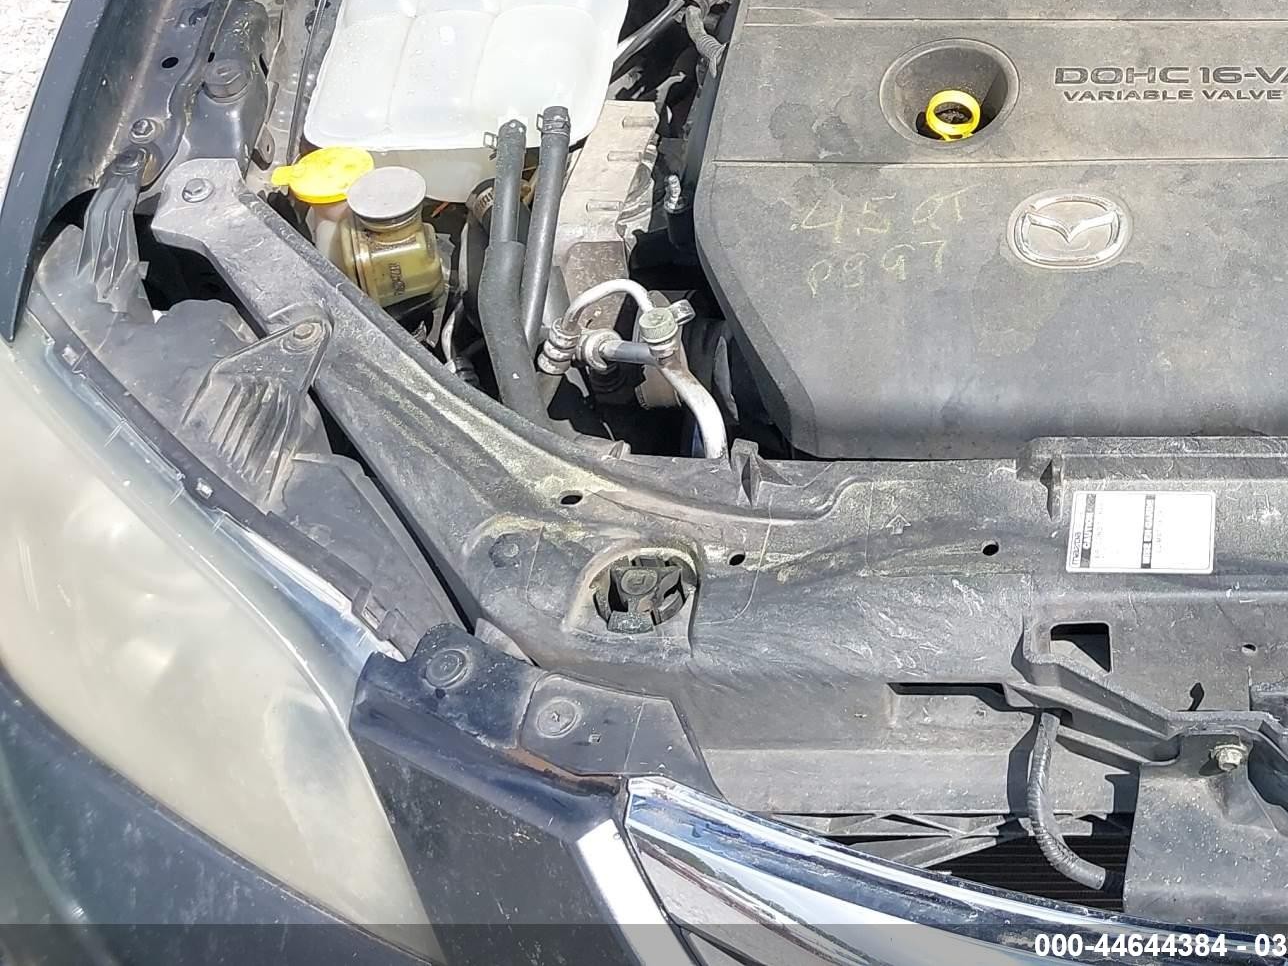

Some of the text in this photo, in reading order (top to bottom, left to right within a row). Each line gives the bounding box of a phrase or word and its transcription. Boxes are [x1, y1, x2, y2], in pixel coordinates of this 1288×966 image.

[1054, 66, 1190, 85] DOHC
[1063, 89, 1194, 102] VARIABLE
[1202, 89, 1283, 101] VALVE
[1083, 511, 1094, 550] CAUTION
[1072, 532, 1082, 565] mazda
